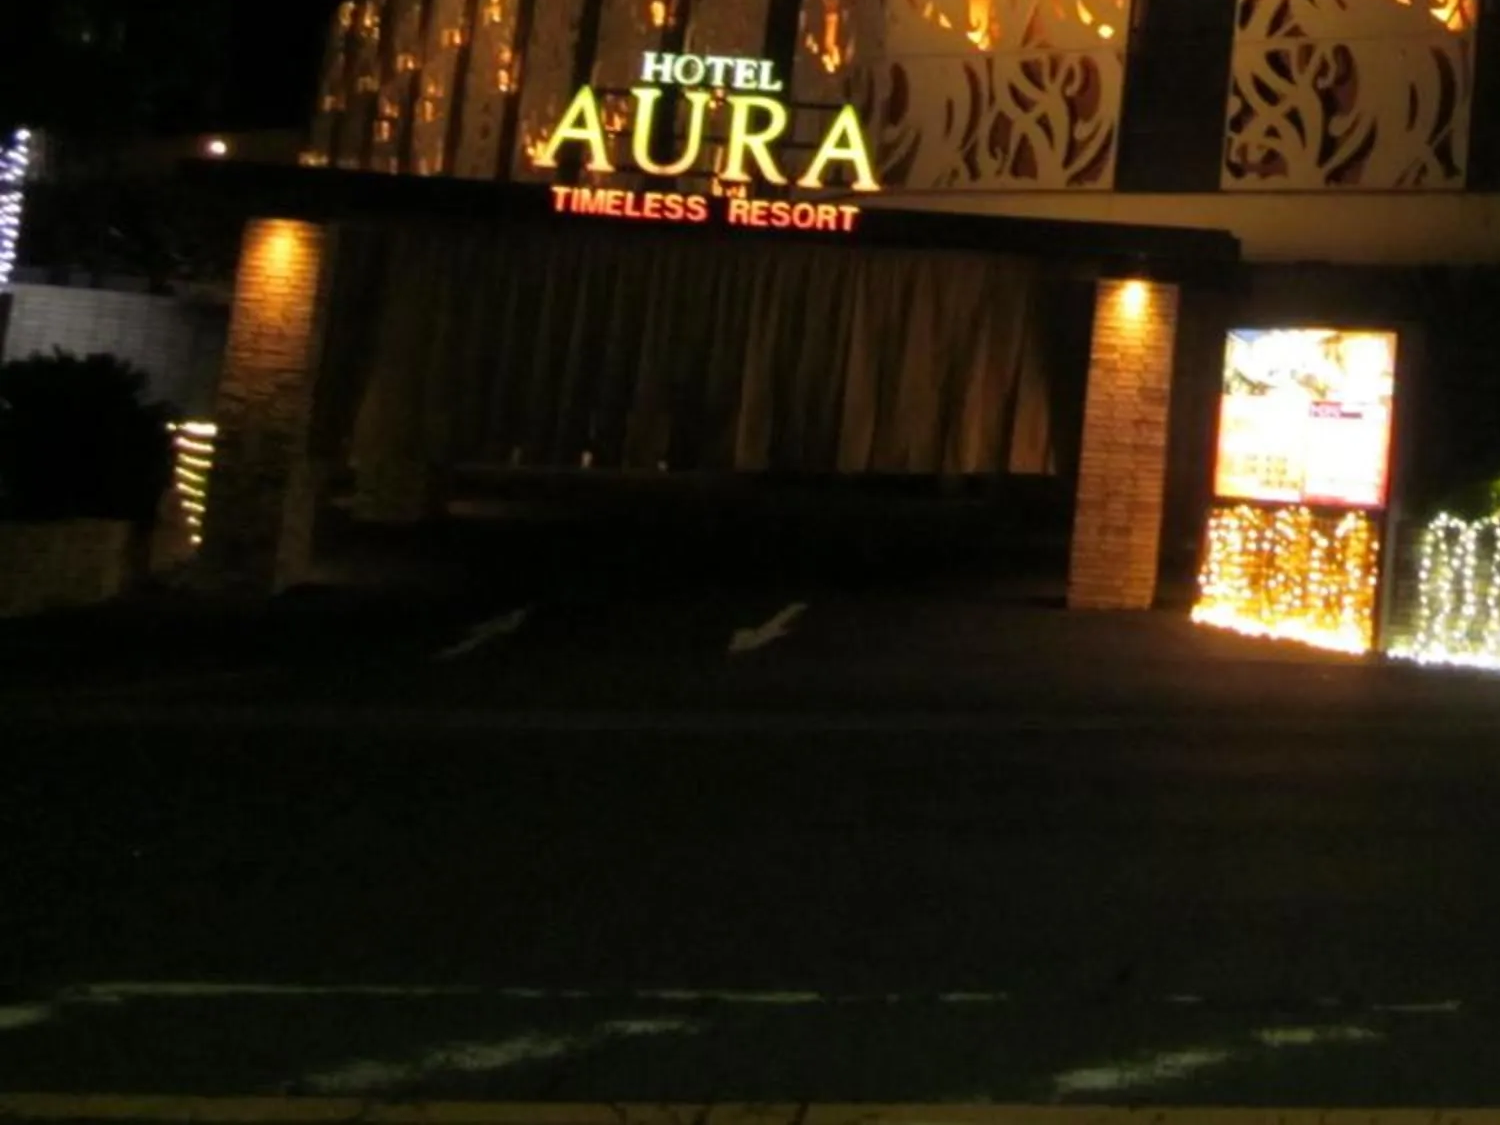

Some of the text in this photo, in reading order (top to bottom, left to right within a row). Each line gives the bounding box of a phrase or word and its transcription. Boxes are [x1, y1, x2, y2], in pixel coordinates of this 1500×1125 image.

[641, 51, 783, 92] HOTEL
[532, 84, 881, 193] AURA
[552, 186, 861, 233] TIMELESS RESORT
